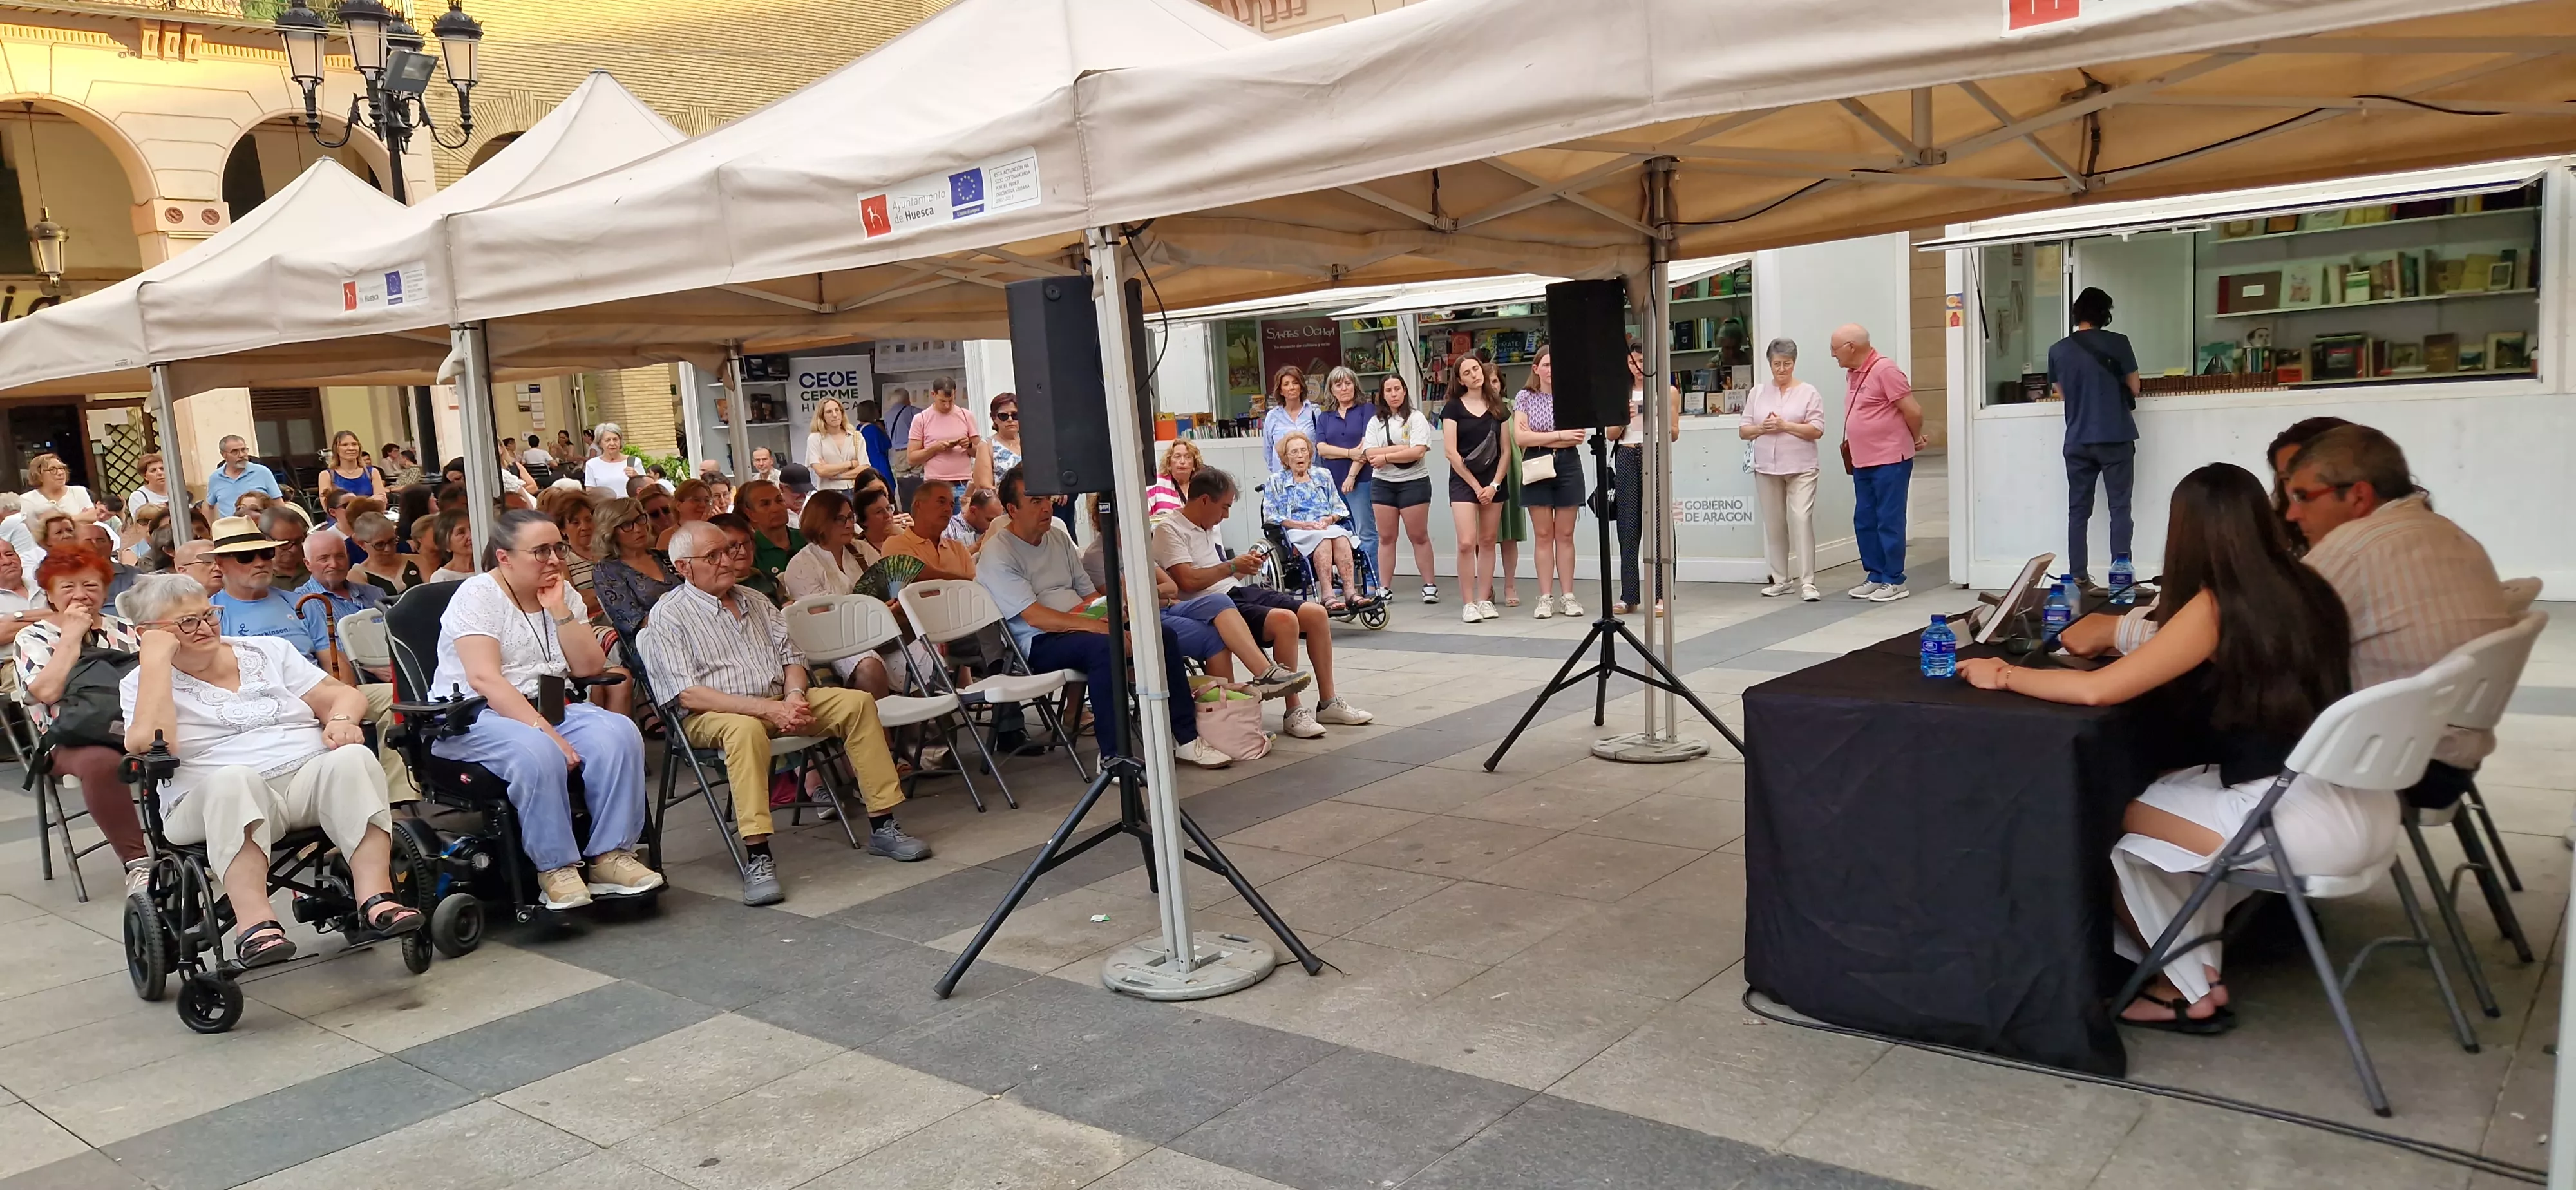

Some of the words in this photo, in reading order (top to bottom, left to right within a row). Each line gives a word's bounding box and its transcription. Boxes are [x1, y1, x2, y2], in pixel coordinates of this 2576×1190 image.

[892, 191, 946, 212] Ayuntamiento
[894, 214, 904, 224] de
[905, 206, 934, 222] Huesca
[799, 370, 858, 388] CEOE
[1685, 500, 1743, 511] GOBIERNO
[1685, 512, 1700, 522] DE
